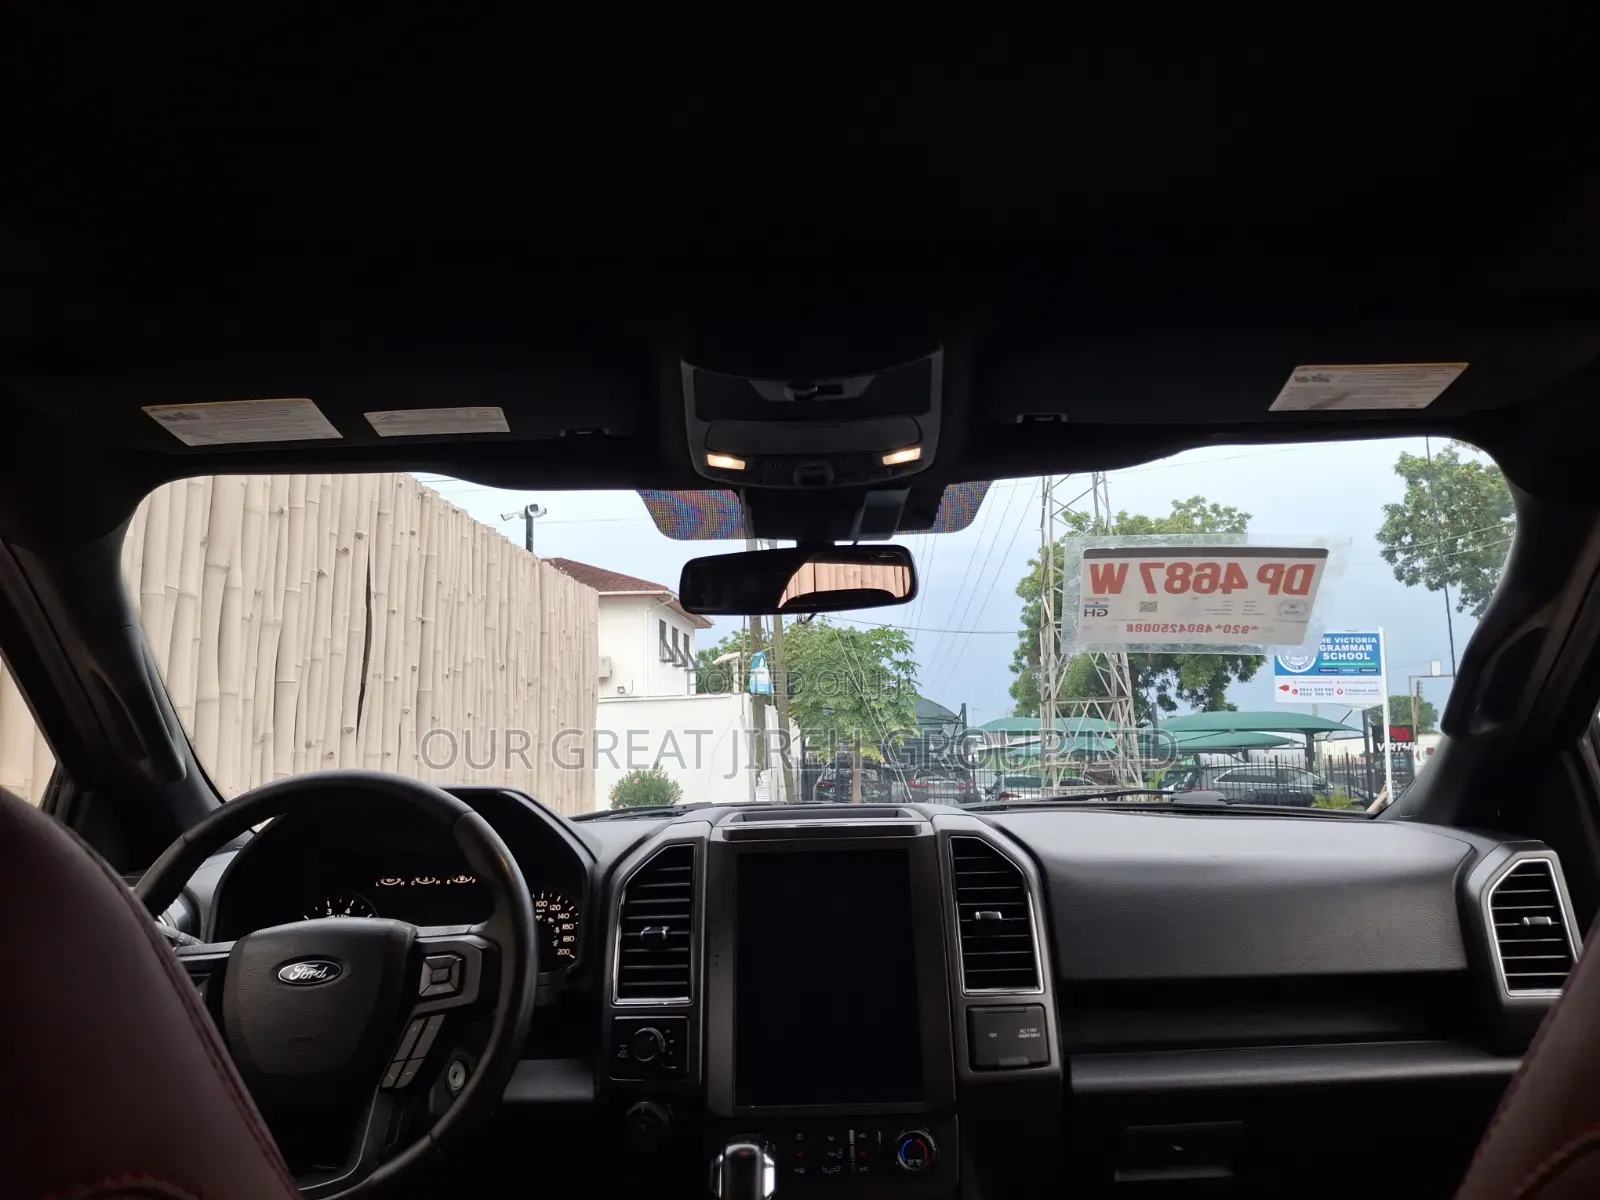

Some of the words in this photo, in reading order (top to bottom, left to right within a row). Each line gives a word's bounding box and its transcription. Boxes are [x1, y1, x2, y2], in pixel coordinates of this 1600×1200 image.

[1320, 644, 1373, 652] GRAMMAR
[1322, 652, 1371, 660] SCHOOL
[289, 962, 328, 980] Ford
